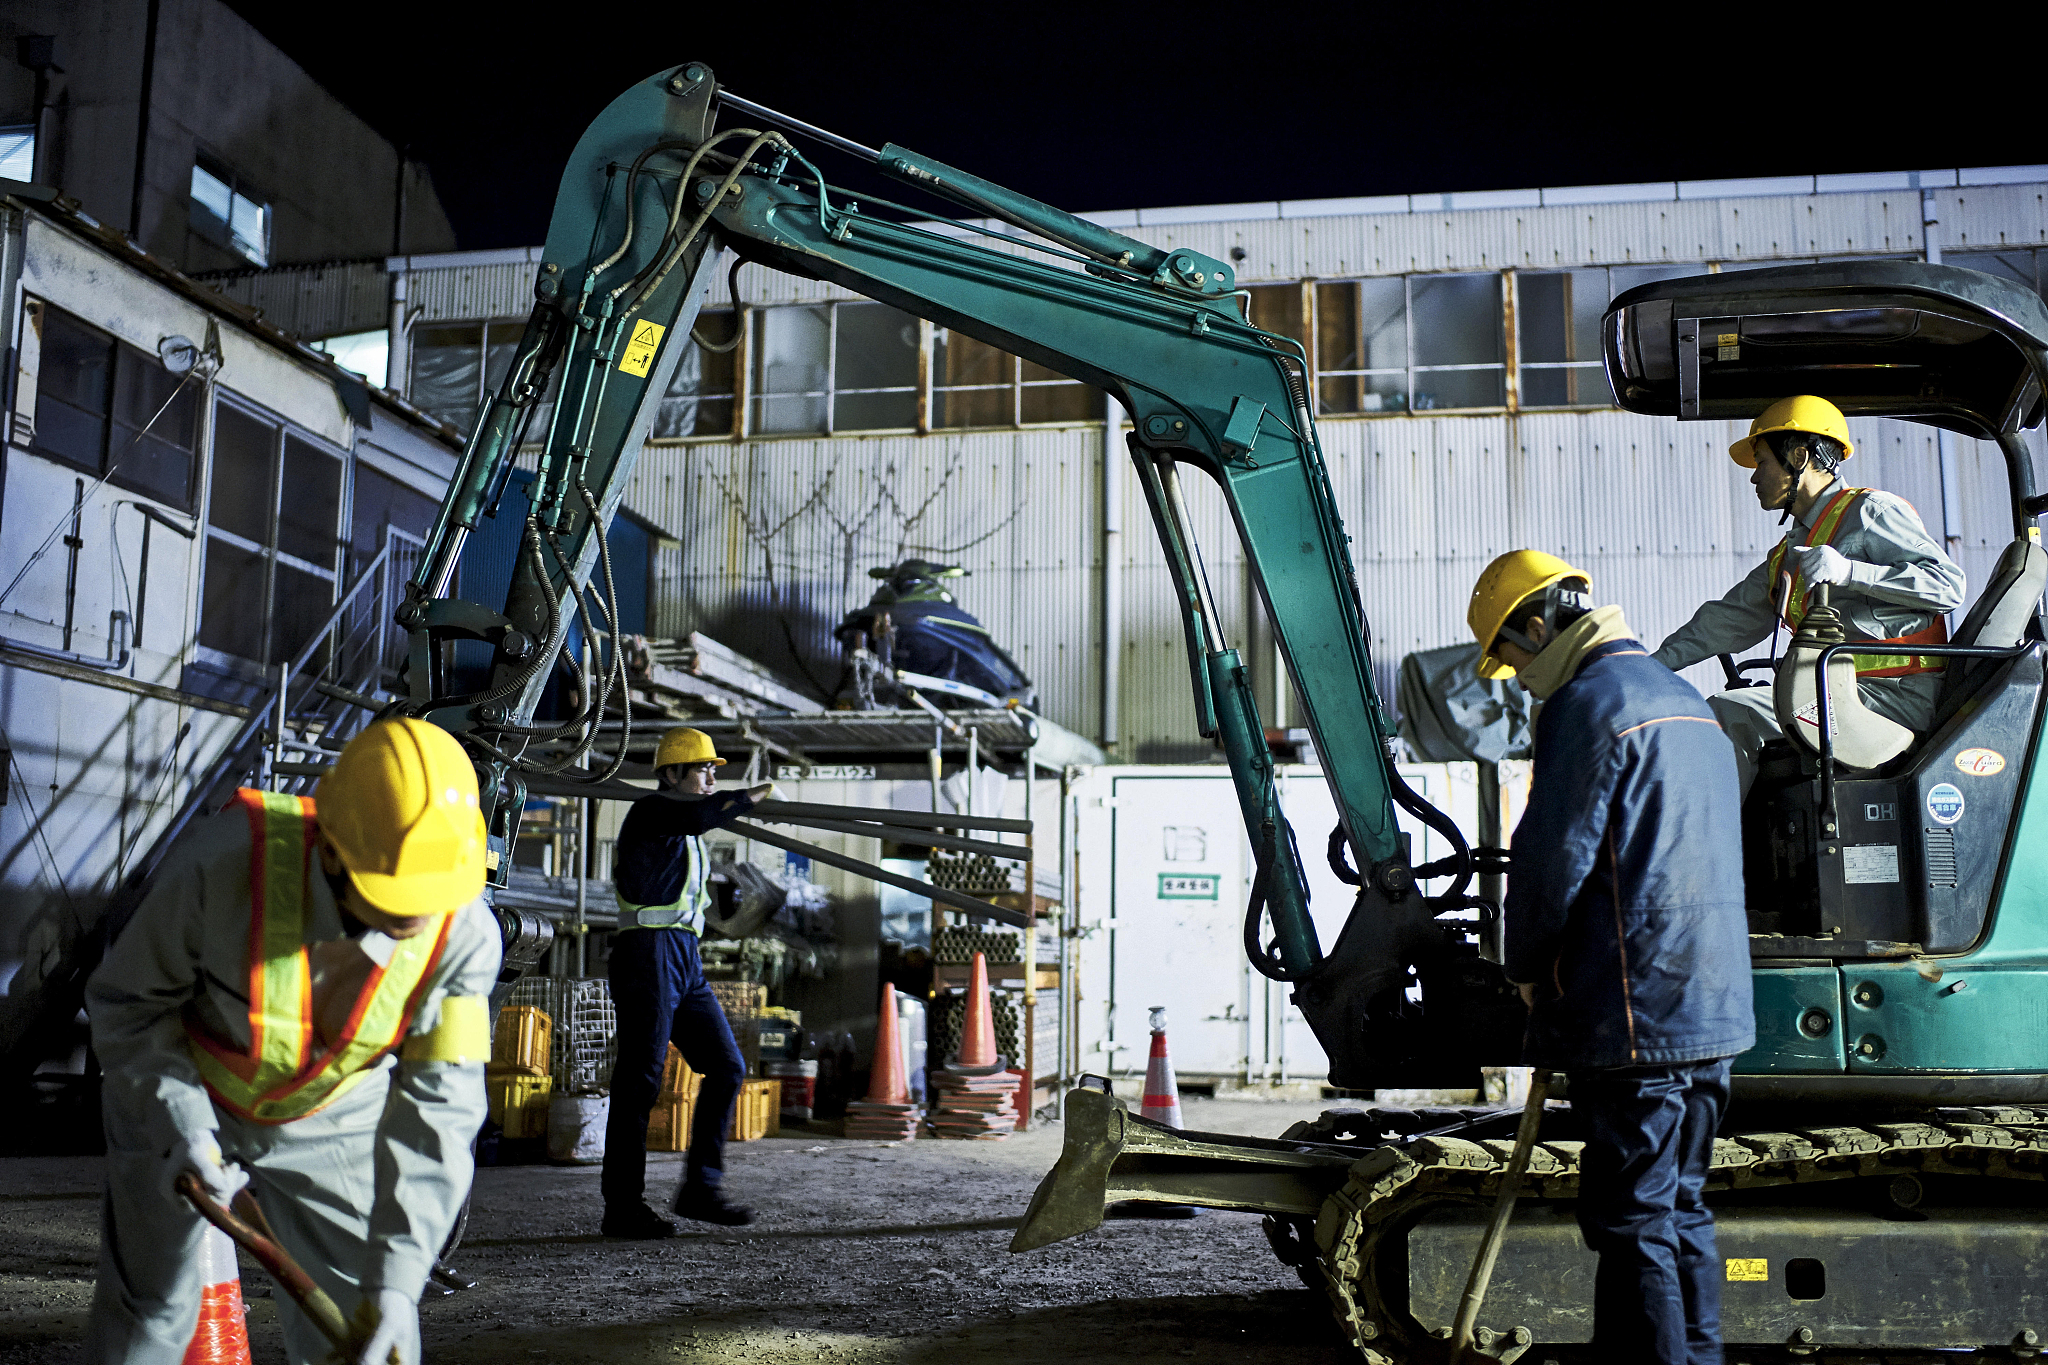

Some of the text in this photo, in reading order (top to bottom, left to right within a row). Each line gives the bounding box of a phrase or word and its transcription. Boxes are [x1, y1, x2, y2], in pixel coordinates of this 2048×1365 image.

[779, 765, 873, 777] スーーハウス
